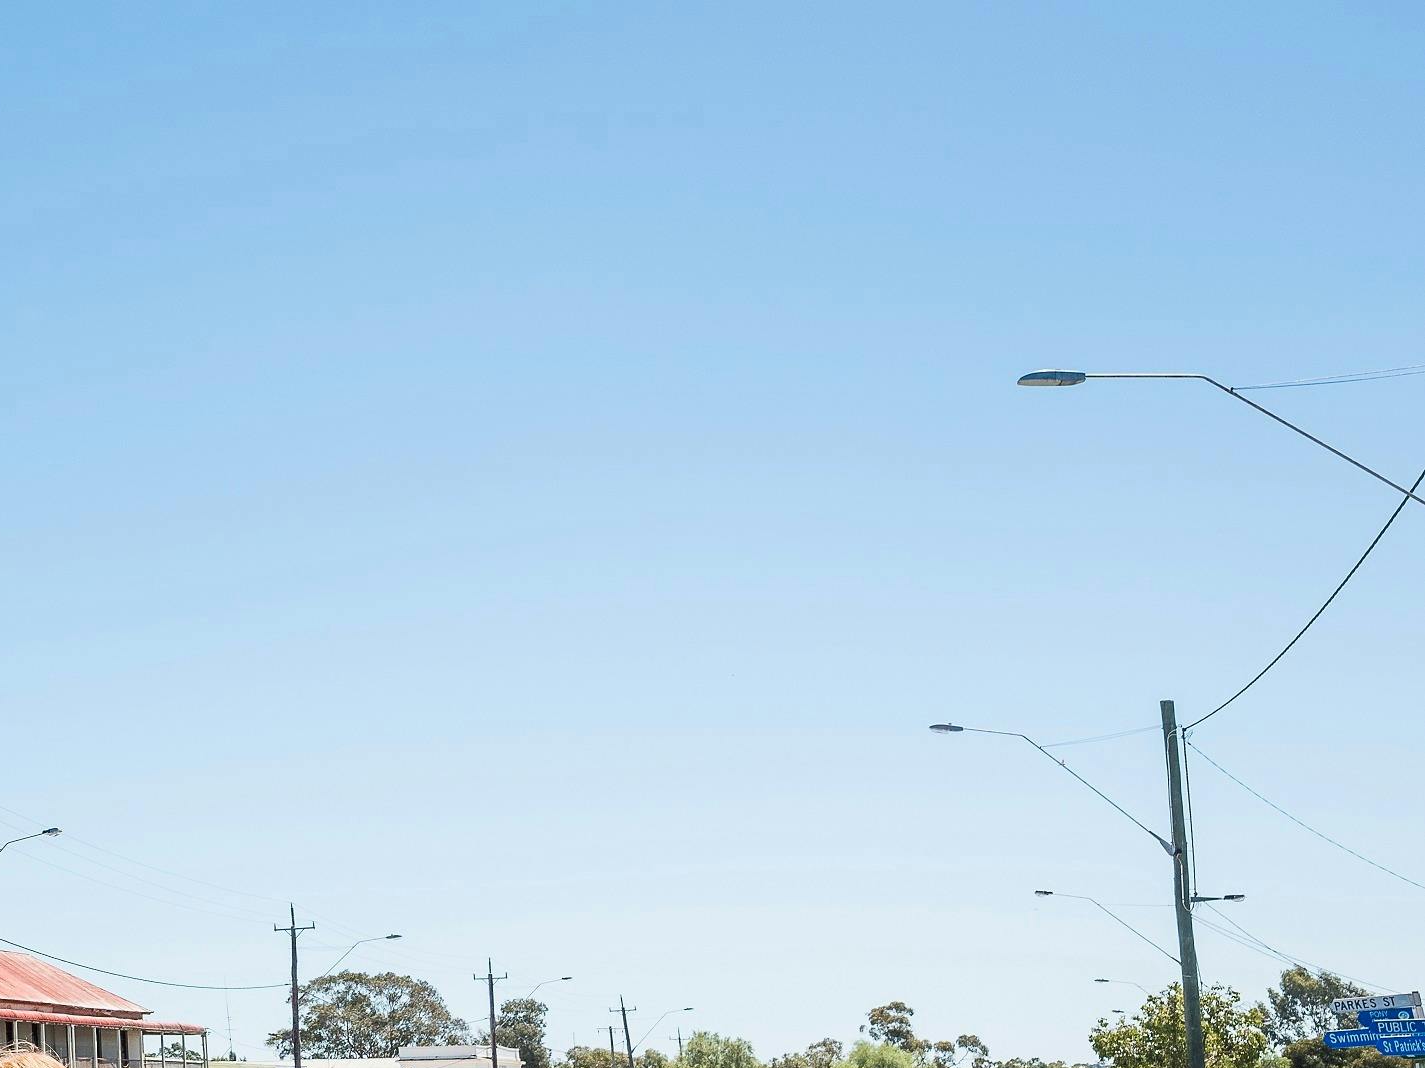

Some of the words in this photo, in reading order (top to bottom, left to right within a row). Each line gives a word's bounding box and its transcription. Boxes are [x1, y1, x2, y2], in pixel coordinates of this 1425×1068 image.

[1334, 999, 1377, 1011] PARKES
[1383, 996, 1396, 1007] ST
[1369, 1010, 1388, 1018] PONY
[1377, 1021, 1417, 1033] PUBLIC
[1329, 1031, 1384, 1044] Swimmin
[1382, 1040, 1393, 1053] St
[1394, 1039, 1425, 1052] Patrick's
